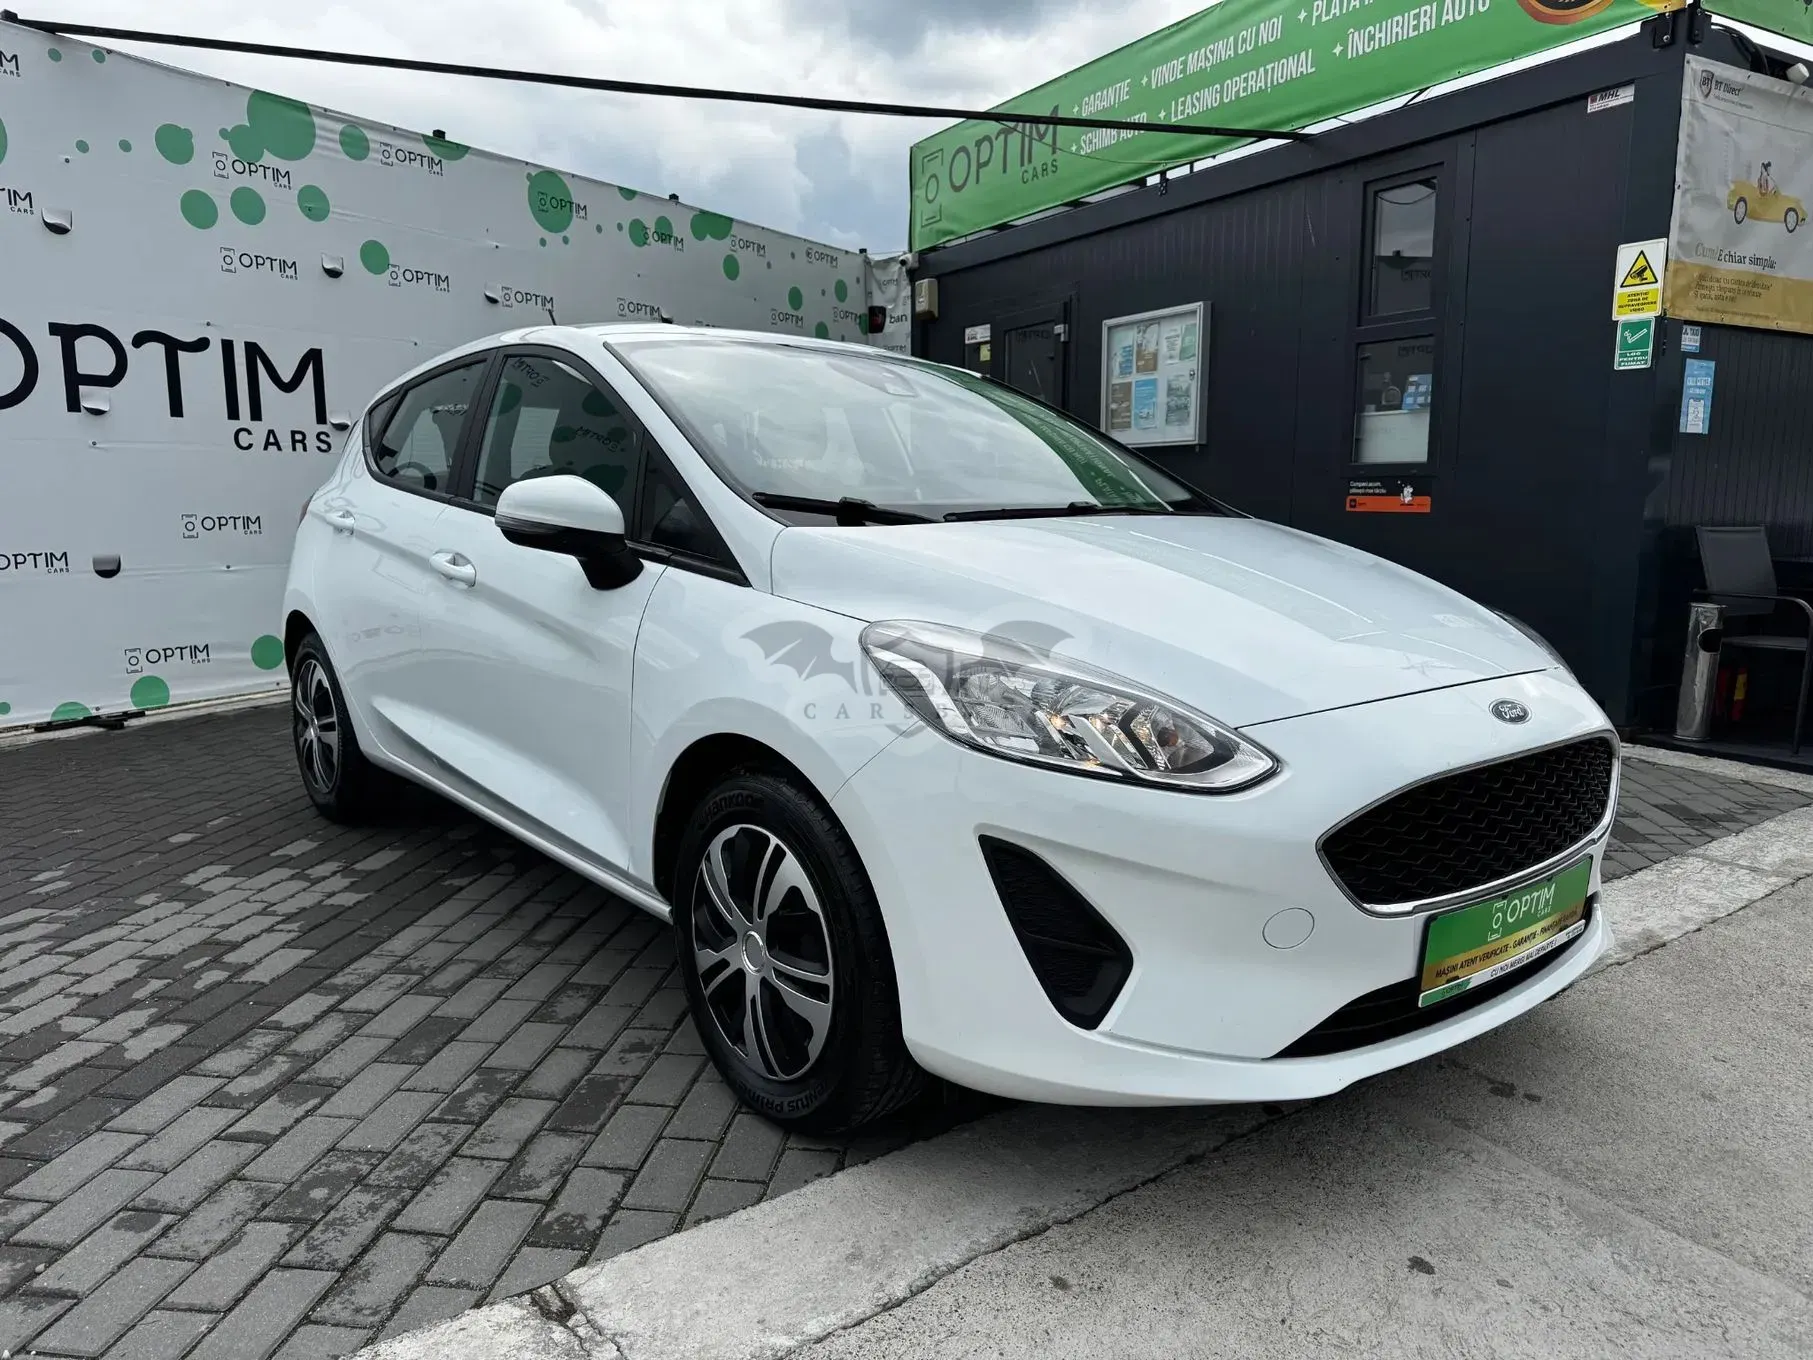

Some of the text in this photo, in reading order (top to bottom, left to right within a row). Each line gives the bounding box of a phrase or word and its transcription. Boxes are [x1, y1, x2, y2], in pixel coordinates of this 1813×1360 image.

[1347, 2, 1437, 60] ÎNCHIRIERI
[1152, 15, 1282, 90] VINDE MAȘINA CU NOI
[1171, 48, 1316, 122] LEASING OPERAȚIONAL
[1714, 80, 1724, 91] BT
[1082, 78, 1132, 117] GARANȚIE
[949, 104, 1060, 192] OPTIM
[1080, 125, 1118, 156] SCHIMB
[395, 150, 443, 172] OPTIM
[1022, 158, 1058, 184] CARS
[232, 159, 290, 184] OPTIM
[550, 200, 588, 216] OPTIM
[652, 230, 684, 248] OPTIM
[738, 238, 766, 256] OPTIM
[238, 253, 297, 276] OPTIM
[814, 250, 838, 266] OPTIM
[1724, 250, 1747, 264] chiar
[402, 269, 450, 289] OPTIM
[514, 291, 554, 309] OPTIM
[628, 302, 661, 318] OPTIM
[778, 312, 804, 327] OPTIM
[840, 310, 861, 326] OPTIM
[234, 428, 332, 453] CARS
[200, 516, 262, 532] OPTIM
[146, 644, 210, 664] OPTIM
[1498, 704, 1524, 719] Ford
[1507, 882, 1556, 923] OPTIM
[1459, 956, 1478, 970] ATENT
[1479, 944, 1510, 962] VERIFICATE
